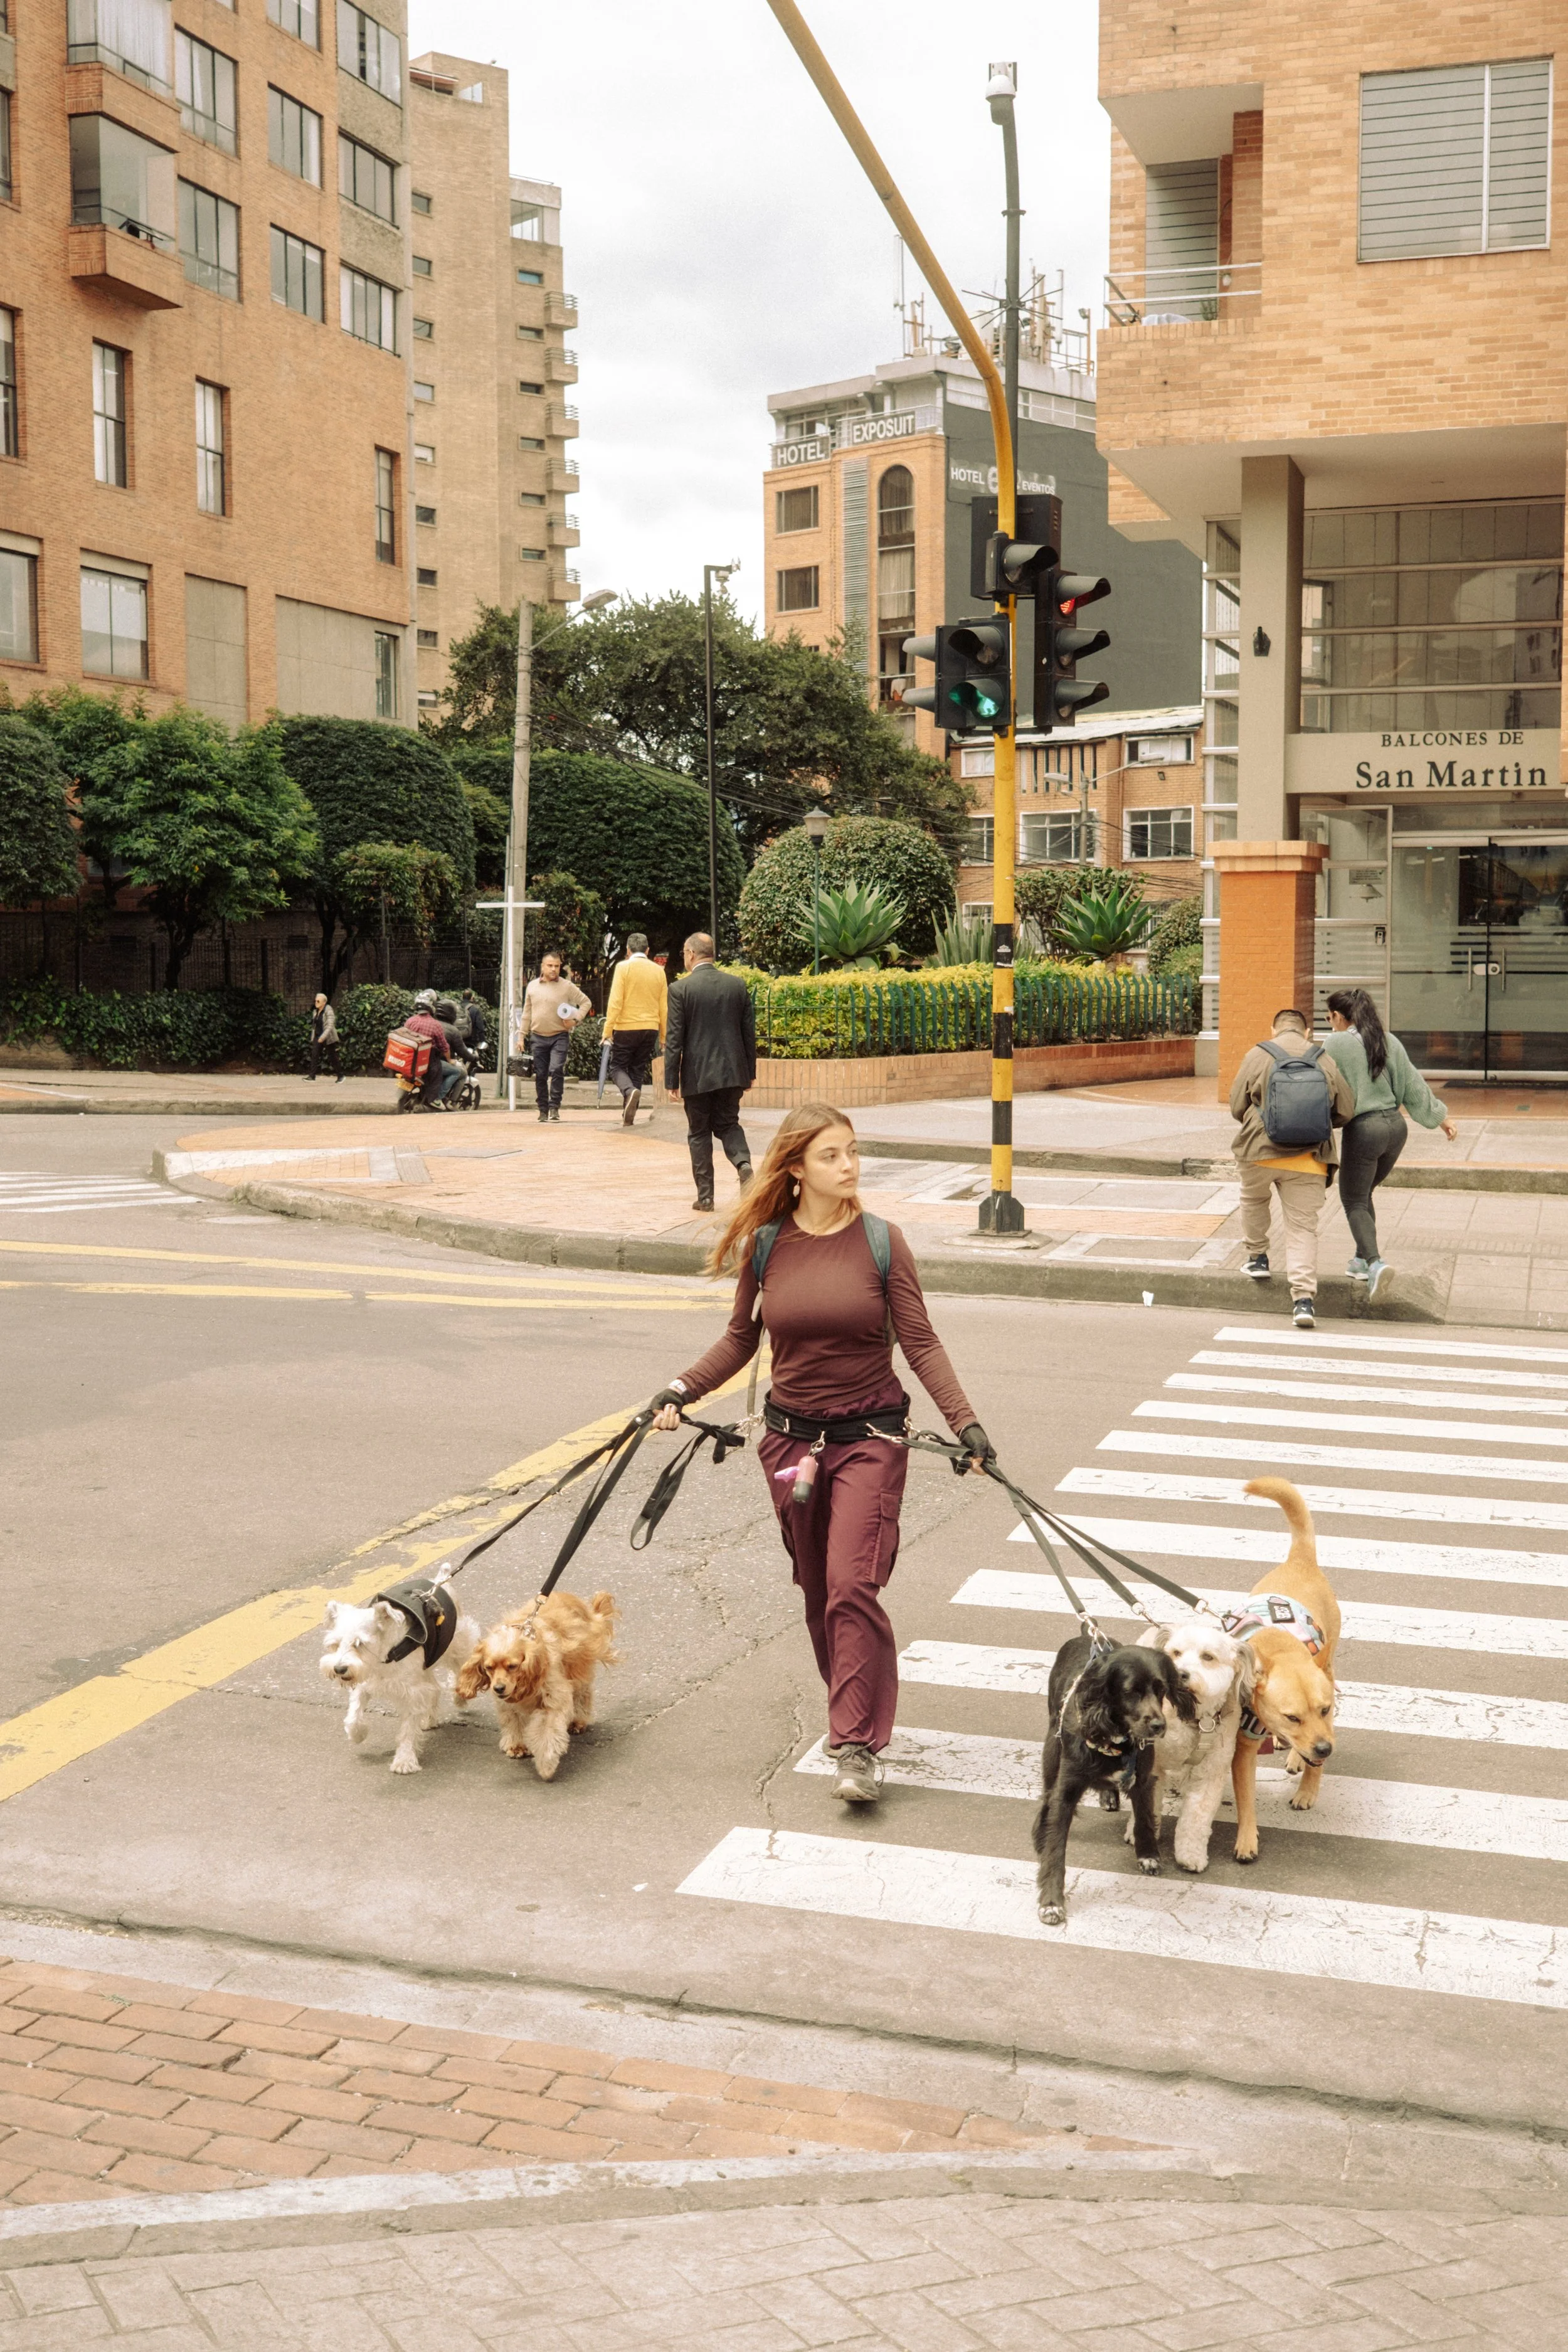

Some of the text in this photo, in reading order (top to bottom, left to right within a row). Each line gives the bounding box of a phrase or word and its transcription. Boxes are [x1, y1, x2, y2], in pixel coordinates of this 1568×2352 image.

[777, 415, 914, 465] HOTEL EXPOSUIT
[950, 467, 985, 485] HOTEL
[1022, 480, 1055, 494] EVENTOS
[1381, 731, 1523, 747] BALCONES DE
[1356, 760, 1547, 788] San Martin
